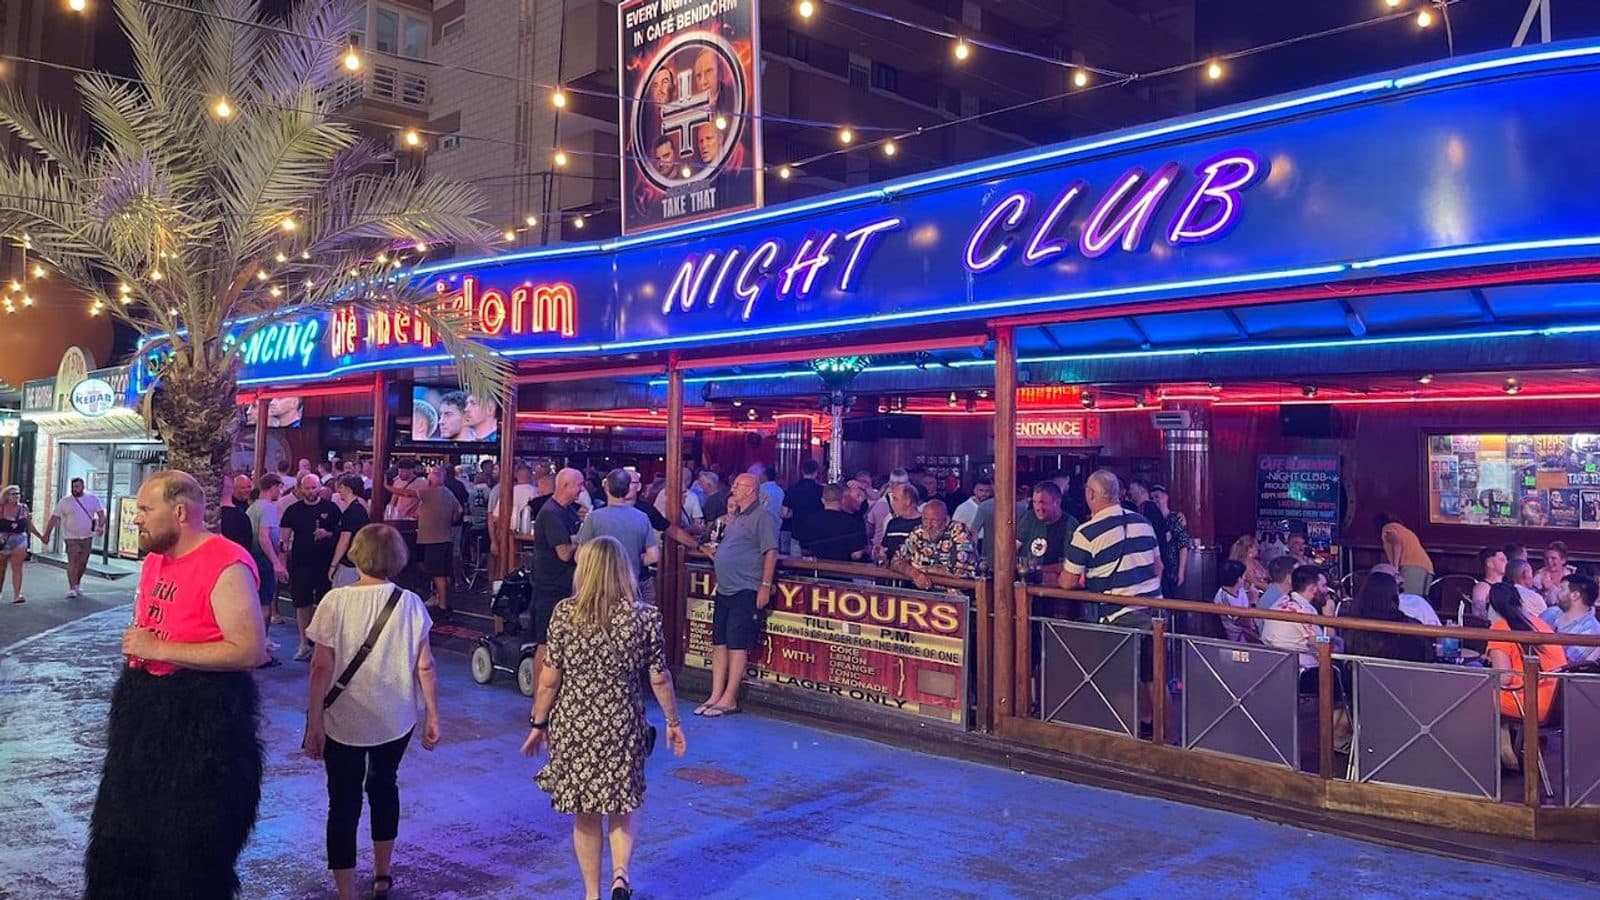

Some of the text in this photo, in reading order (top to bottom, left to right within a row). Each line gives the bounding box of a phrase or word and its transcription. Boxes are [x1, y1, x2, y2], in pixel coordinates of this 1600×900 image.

[626, 0, 692, 29] EVERY NIG
[633, 0, 738, 47] IN CAFÉ BENIDORM
[661, 194, 686, 219] TAKE
[689, 187, 717, 212] THAT
[661, 156, 1258, 320] NIGHT CLUB
[223, 318, 319, 368] NCING
[1015, 421, 1081, 436] ENTRANCE
[811, 587, 959, 631] HOURS
[769, 622, 787, 634] TWO
[787, 625, 809, 638] PINTS
[823, 630, 853, 645] LAGER
[854, 636, 872, 647] FOR
[873, 639, 892, 650] THE
[893, 642, 920, 655] PRICE
[923, 648, 936, 659] OF
[938, 651, 959, 663] ONE
[802, 616, 916, 643] TILL P.M.
[782, 648, 815, 663] WITH
[829, 644, 860, 656] COKE
[829, 653, 867, 665] LEMON
[829, 660, 876, 675] ORANGE
[829, 668, 861, 680] TONIC
[746, 668, 908, 710] OF LAGER ONLY
[828, 675, 889, 694] LEMONADE
